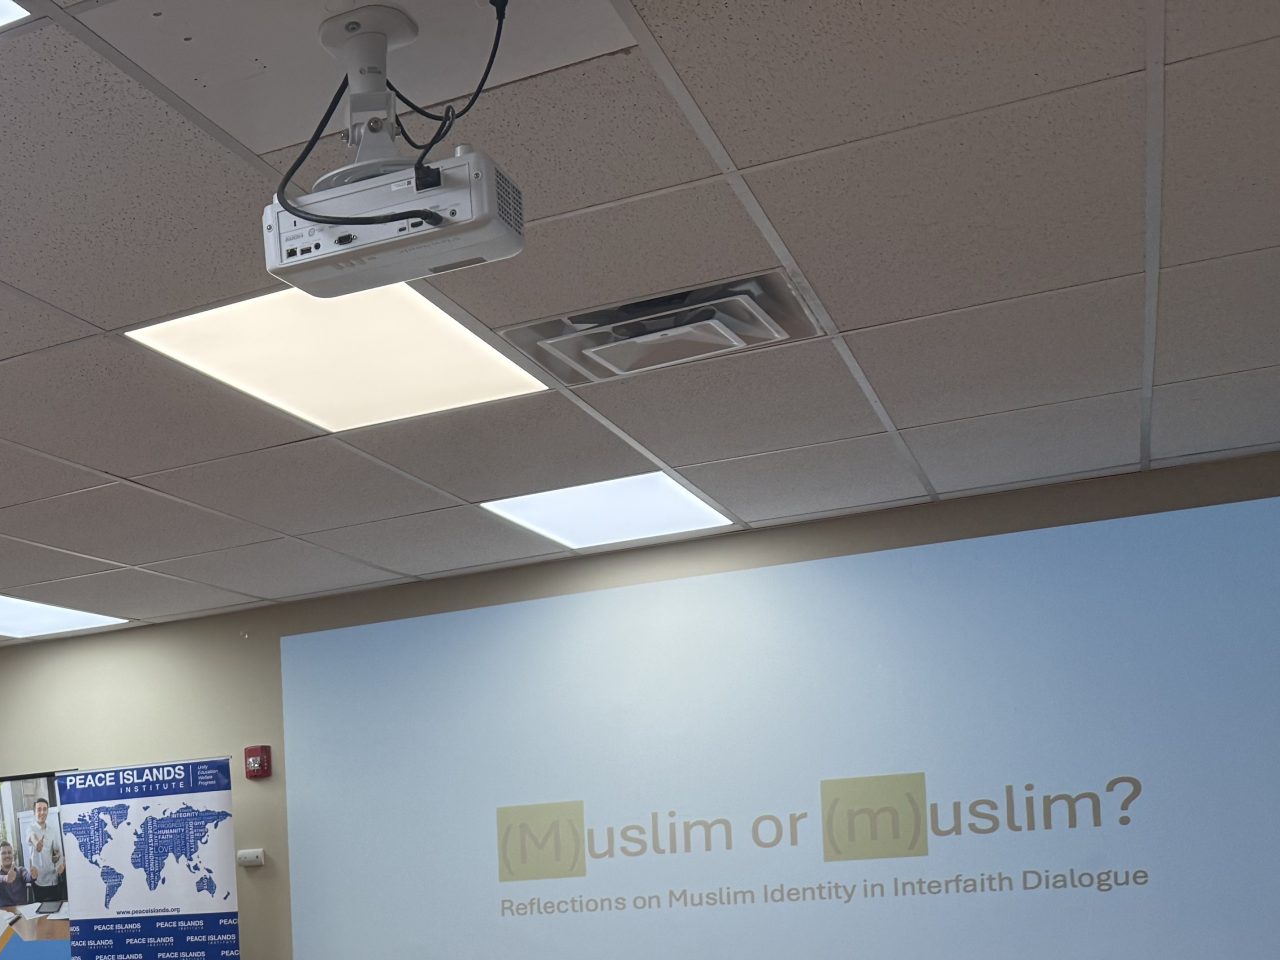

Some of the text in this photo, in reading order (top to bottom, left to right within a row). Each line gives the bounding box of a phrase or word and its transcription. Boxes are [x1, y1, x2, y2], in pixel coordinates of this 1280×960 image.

[66, 766, 185, 789] PEACE ISLANDS
[120, 781, 184, 793] INSTITUTE
[500, 775, 1144, 874] (M)uslim or (m)uslim?
[500, 865, 1150, 916] Reflections on Muslim Identity in Interfaith Dialogue
